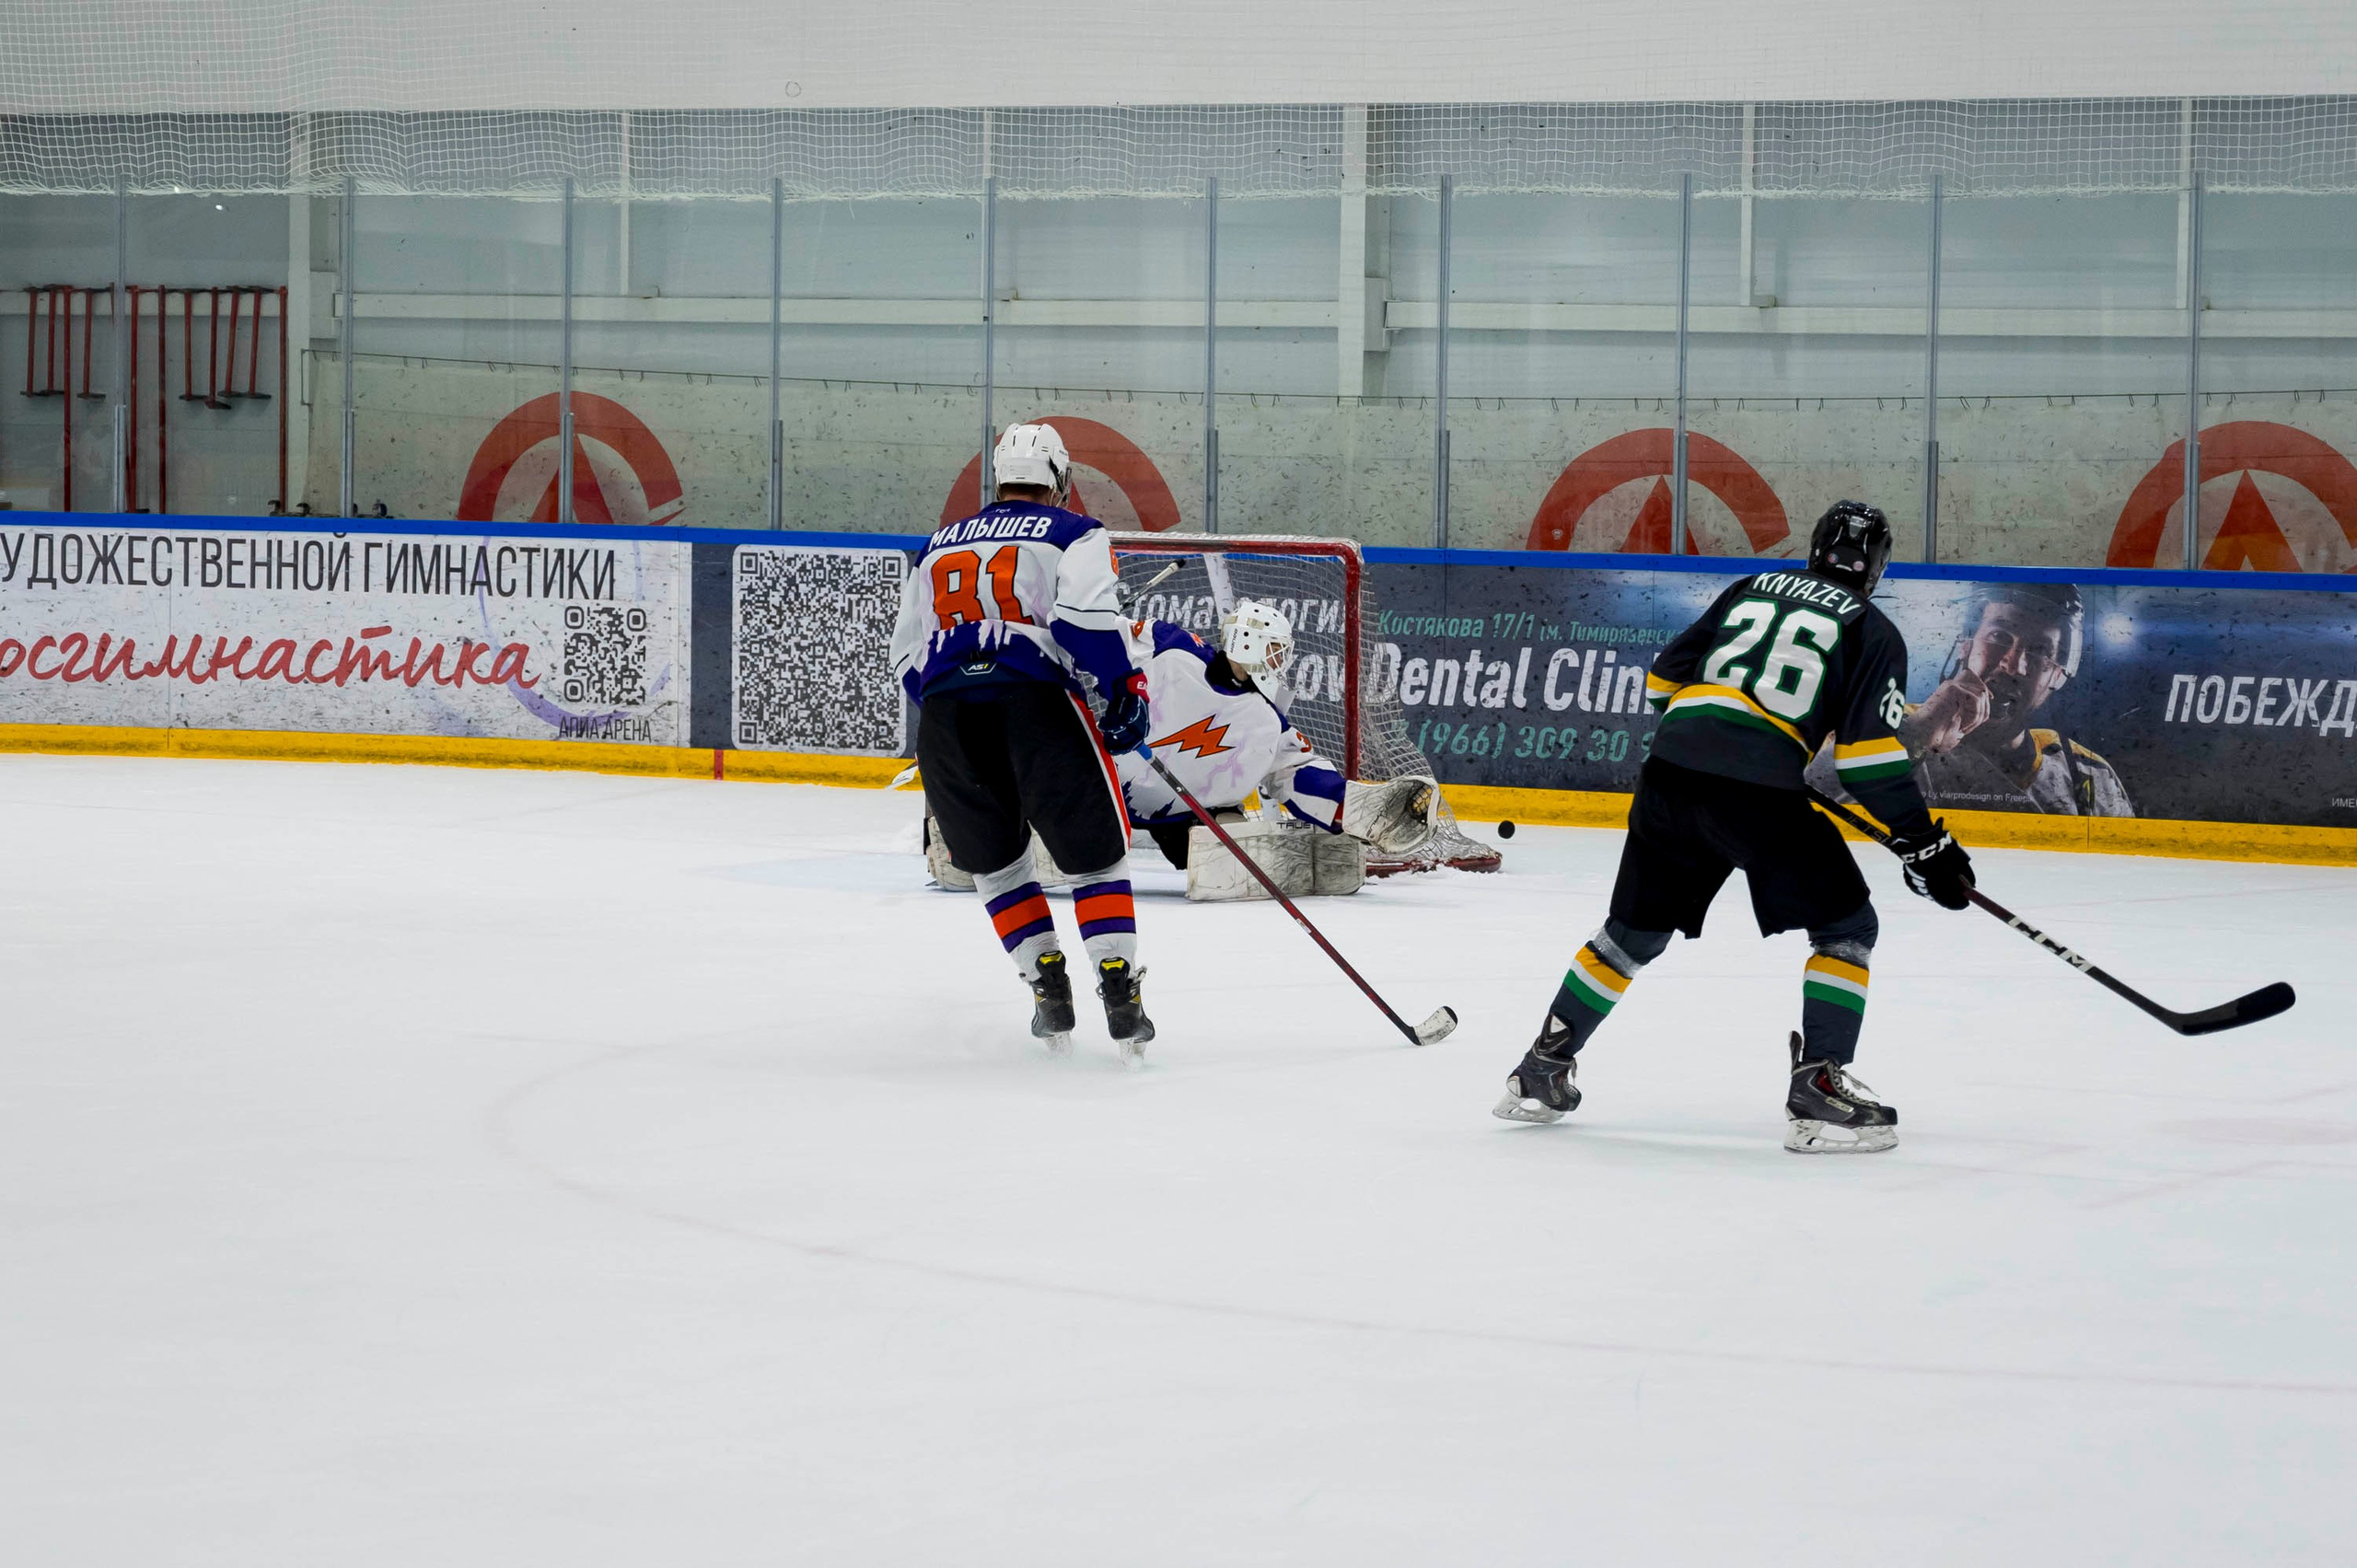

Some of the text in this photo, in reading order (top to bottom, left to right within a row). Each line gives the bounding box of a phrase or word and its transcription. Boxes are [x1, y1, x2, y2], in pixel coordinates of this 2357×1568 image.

[928, 516, 1052, 552] МАЛЫШЕВ
[0, 532, 615, 600] УДОЖЕСТВЕННОЙ ГИМНАСТИКИ
[930, 545, 1035, 633] 81
[1752, 572, 1862, 616] KNYAZEV
[1377, 610, 1484, 638] Костякова
[1570, 621, 1685, 645] Тимирязевск
[1365, 642, 1532, 710] Dental
[1703, 598, 1842, 722] 26
[2165, 674, 2357, 738] ПОБЕЖД
[602, 717, 652, 743] АРЕНА
[1417, 718, 1506, 761] (966)
[1515, 725, 1577, 760] 309
[1586, 728, 1630, 762] 30
[1993, 794, 2003, 802] on
[2331, 797, 2357, 808] ИМЕ
[1899, 830, 1953, 865] CCM
